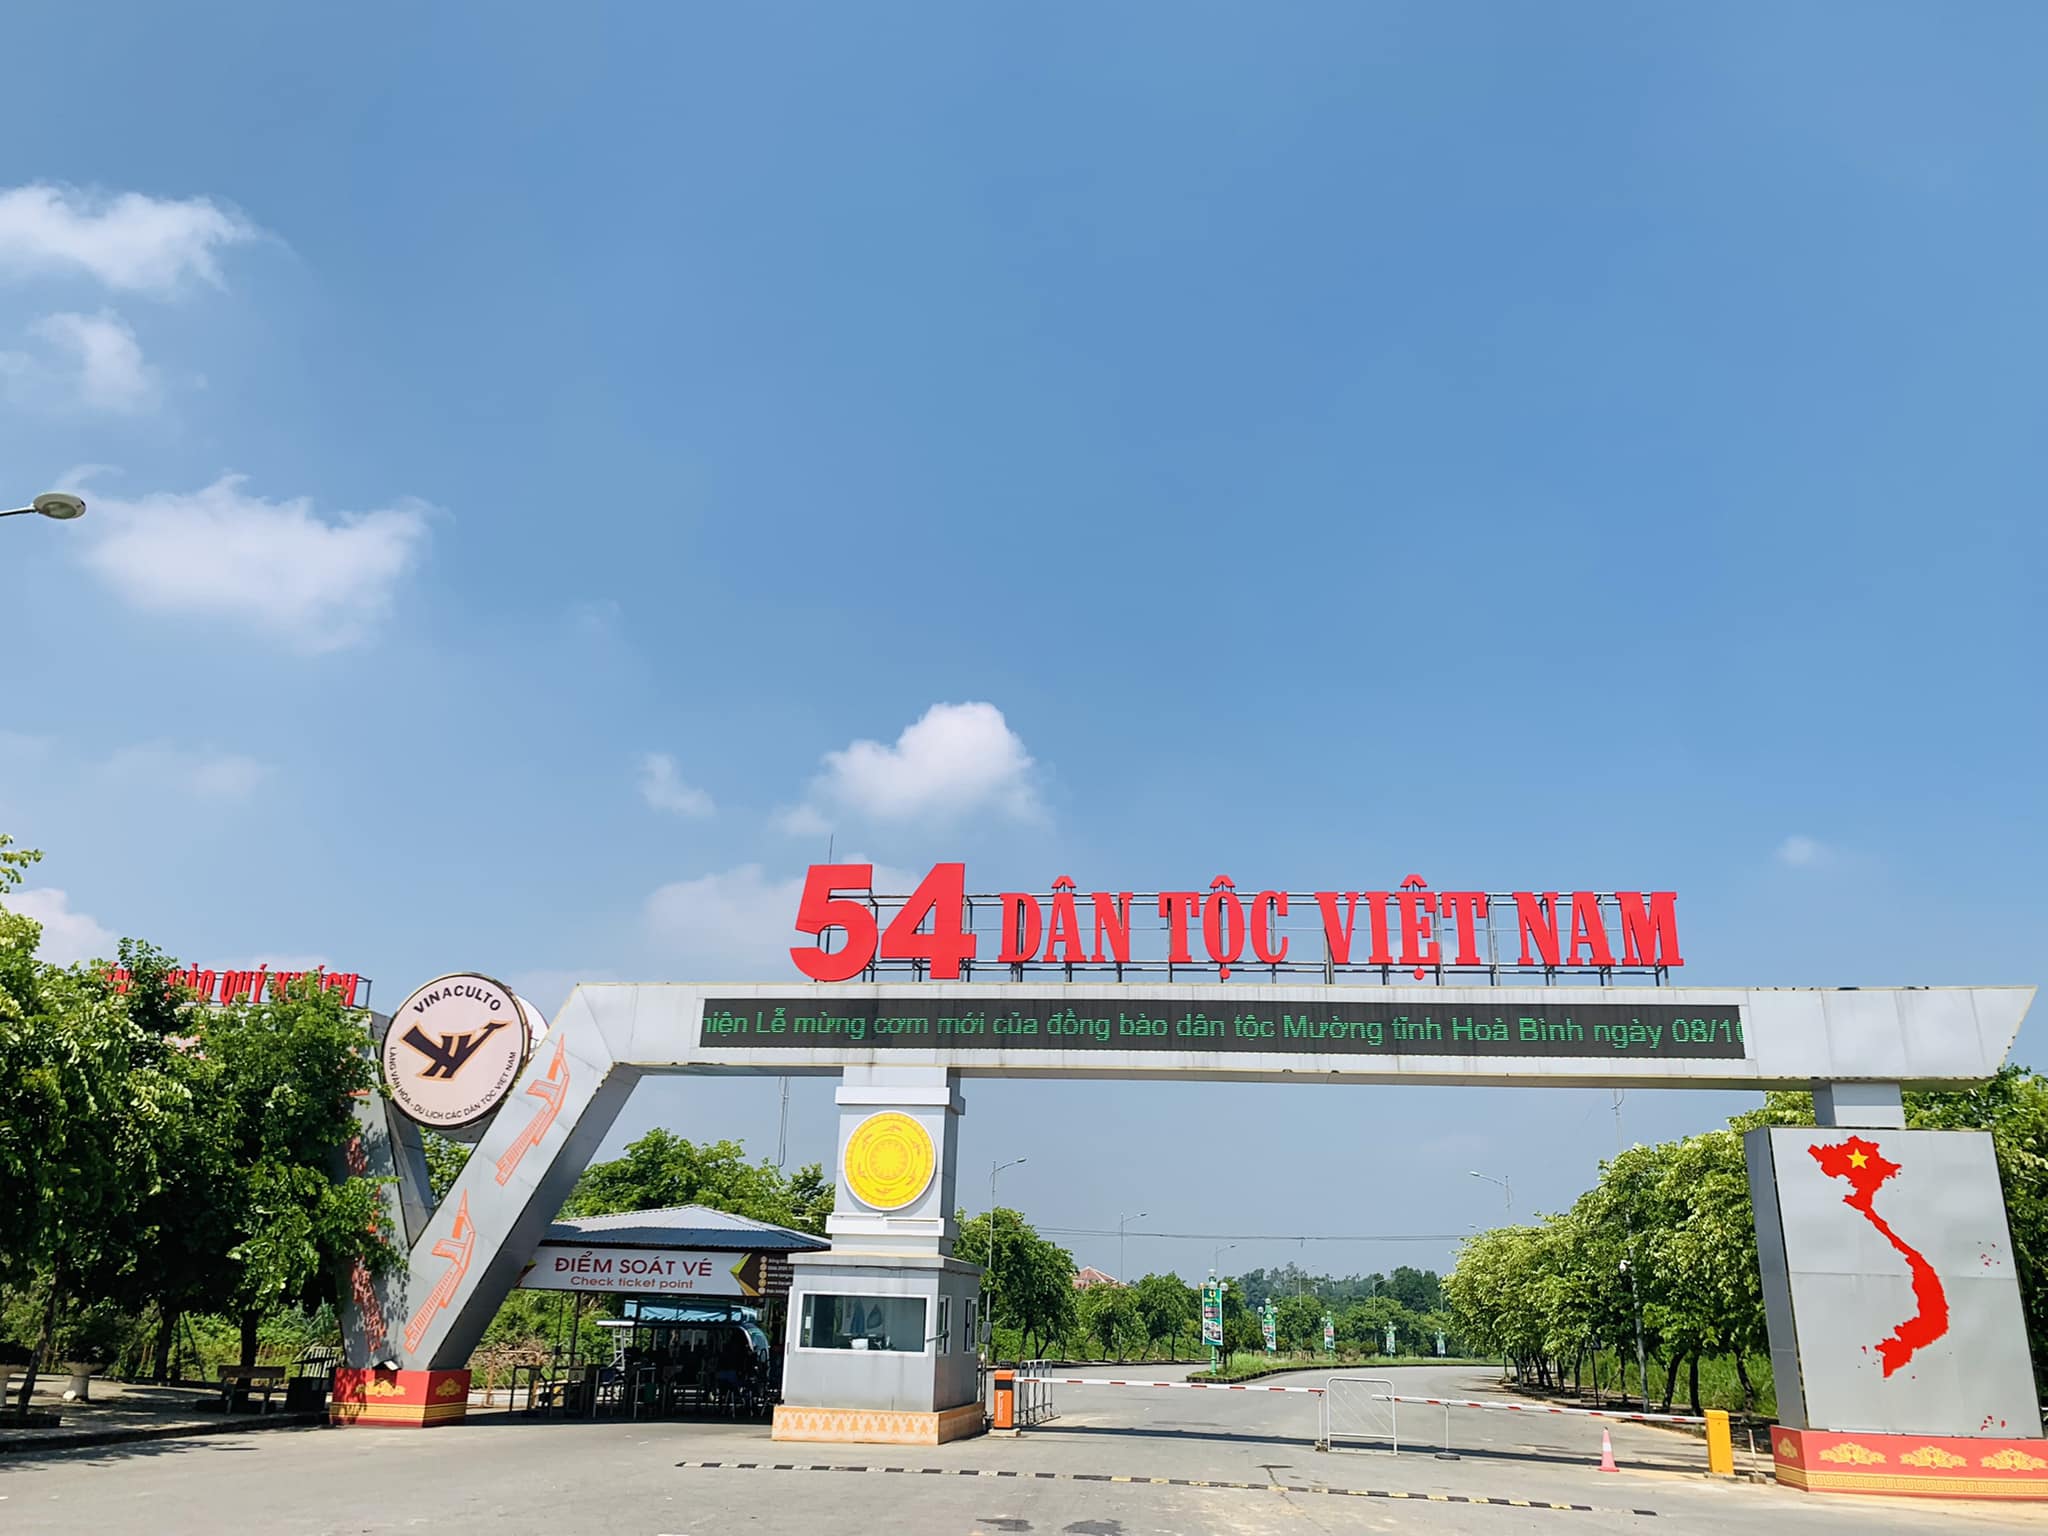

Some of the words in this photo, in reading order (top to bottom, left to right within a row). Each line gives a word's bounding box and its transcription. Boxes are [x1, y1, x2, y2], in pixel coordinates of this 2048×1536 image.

[789, 863, 977, 982] 54
[997, 875, 1133, 964] DÂN
[1158, 874, 1290, 980] TỘC
[1314, 874, 1489, 980] VIỆT
[1511, 891, 1684, 967] NAM
[219, 963, 267, 1007] QUÝ
[413, 985, 501, 1013] VINACULTO
[756, 1007, 786, 1033] Lễ
[793, 1011, 866, 1040] mừng
[873, 1017, 929, 1034] cơm
[937, 1011, 985, 1034] mới
[992, 1011, 1039, 1034] của
[1047, 1008, 1111, 1041] đồng
[1119, 1012, 1169, 1036] bào
[1176, 1013, 1226, 1037] dân
[1234, 1014, 1276, 1041] tộc
[1283, 1015, 1384, 1046] Mường
[1452, 1016, 1509, 1041] Hoà
[1519, 1017, 1584, 1042] Bình
[1593, 1018, 1663, 1049] ngày
[555, 1251, 612, 1273] ĐIỂM
[619, 1256, 676, 1275] SOÁT
[683, 1257, 713, 1277] VÉ
[570, 1275, 613, 1287] Check
[618, 1277, 656, 1288] ticket
[659, 1278, 693, 1289] point
